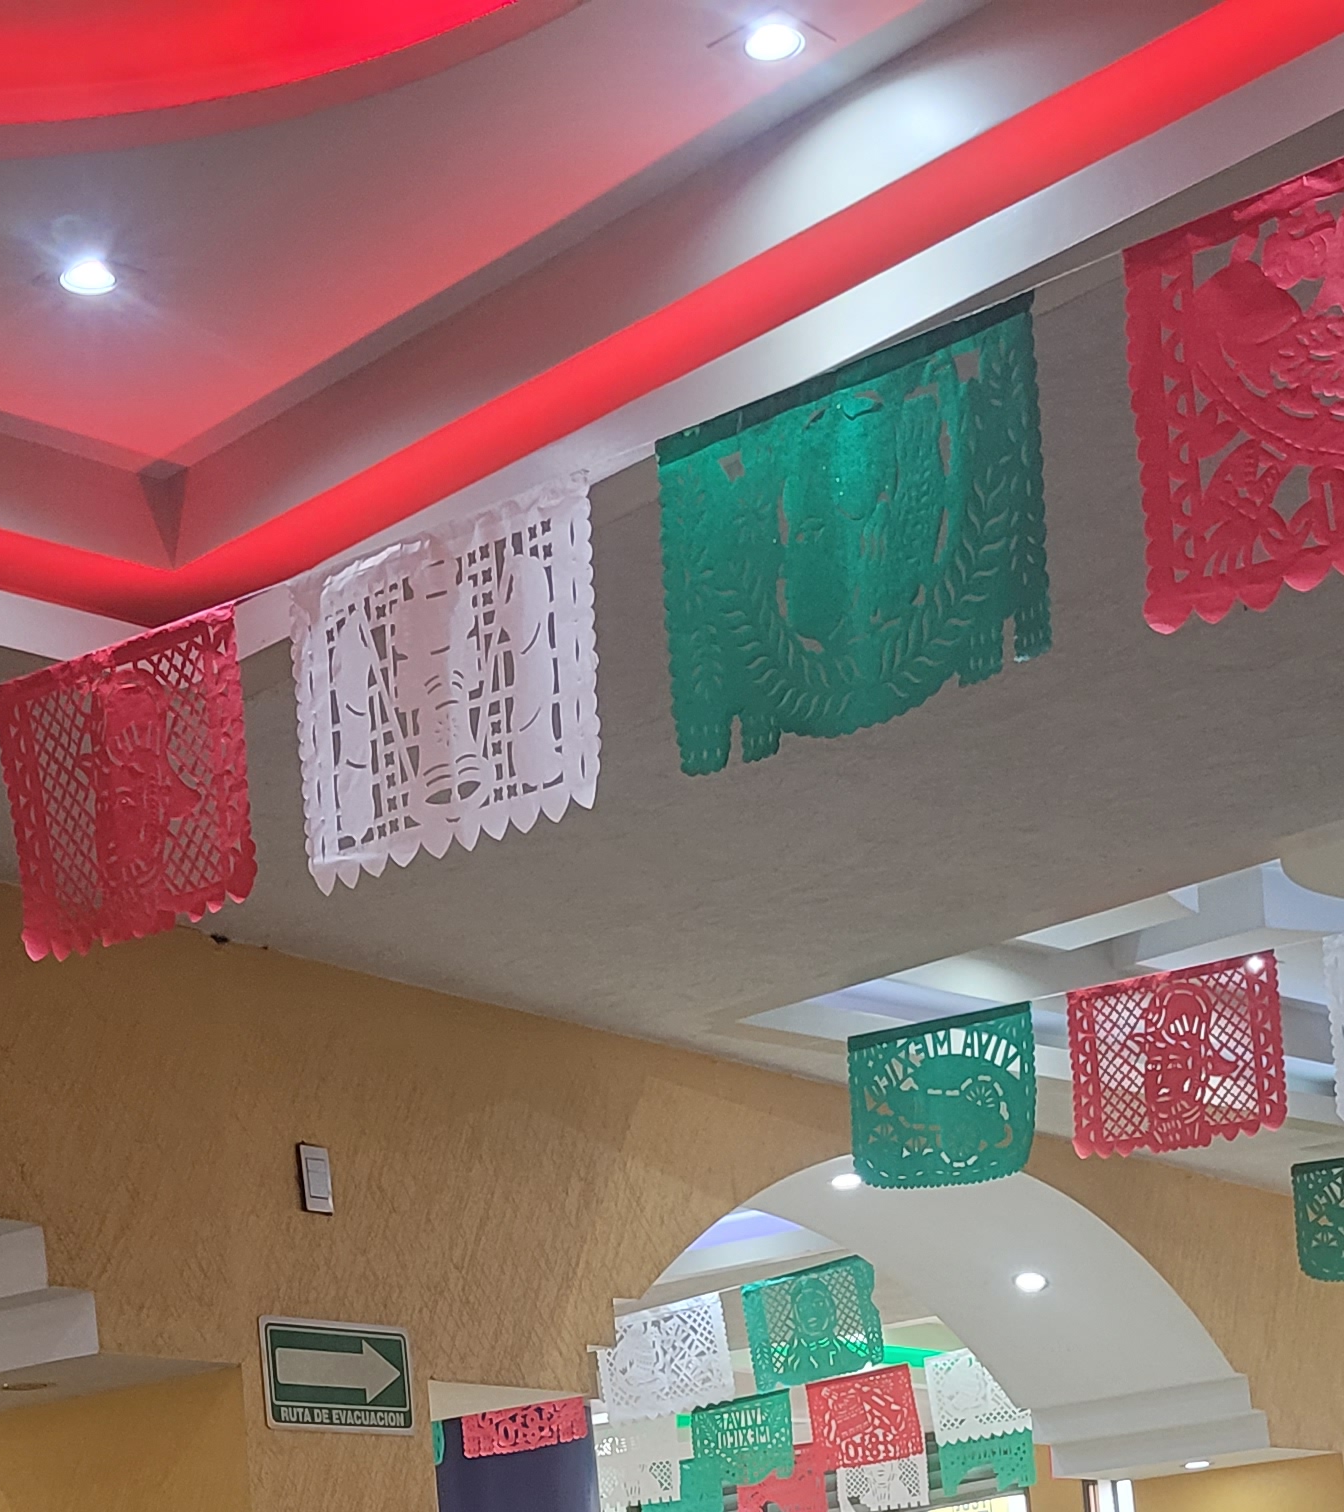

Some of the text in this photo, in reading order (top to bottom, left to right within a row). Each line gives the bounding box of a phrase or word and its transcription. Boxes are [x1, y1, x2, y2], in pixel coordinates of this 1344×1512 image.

[280, 1406, 405, 1427] RUTA DE EVACUACION
